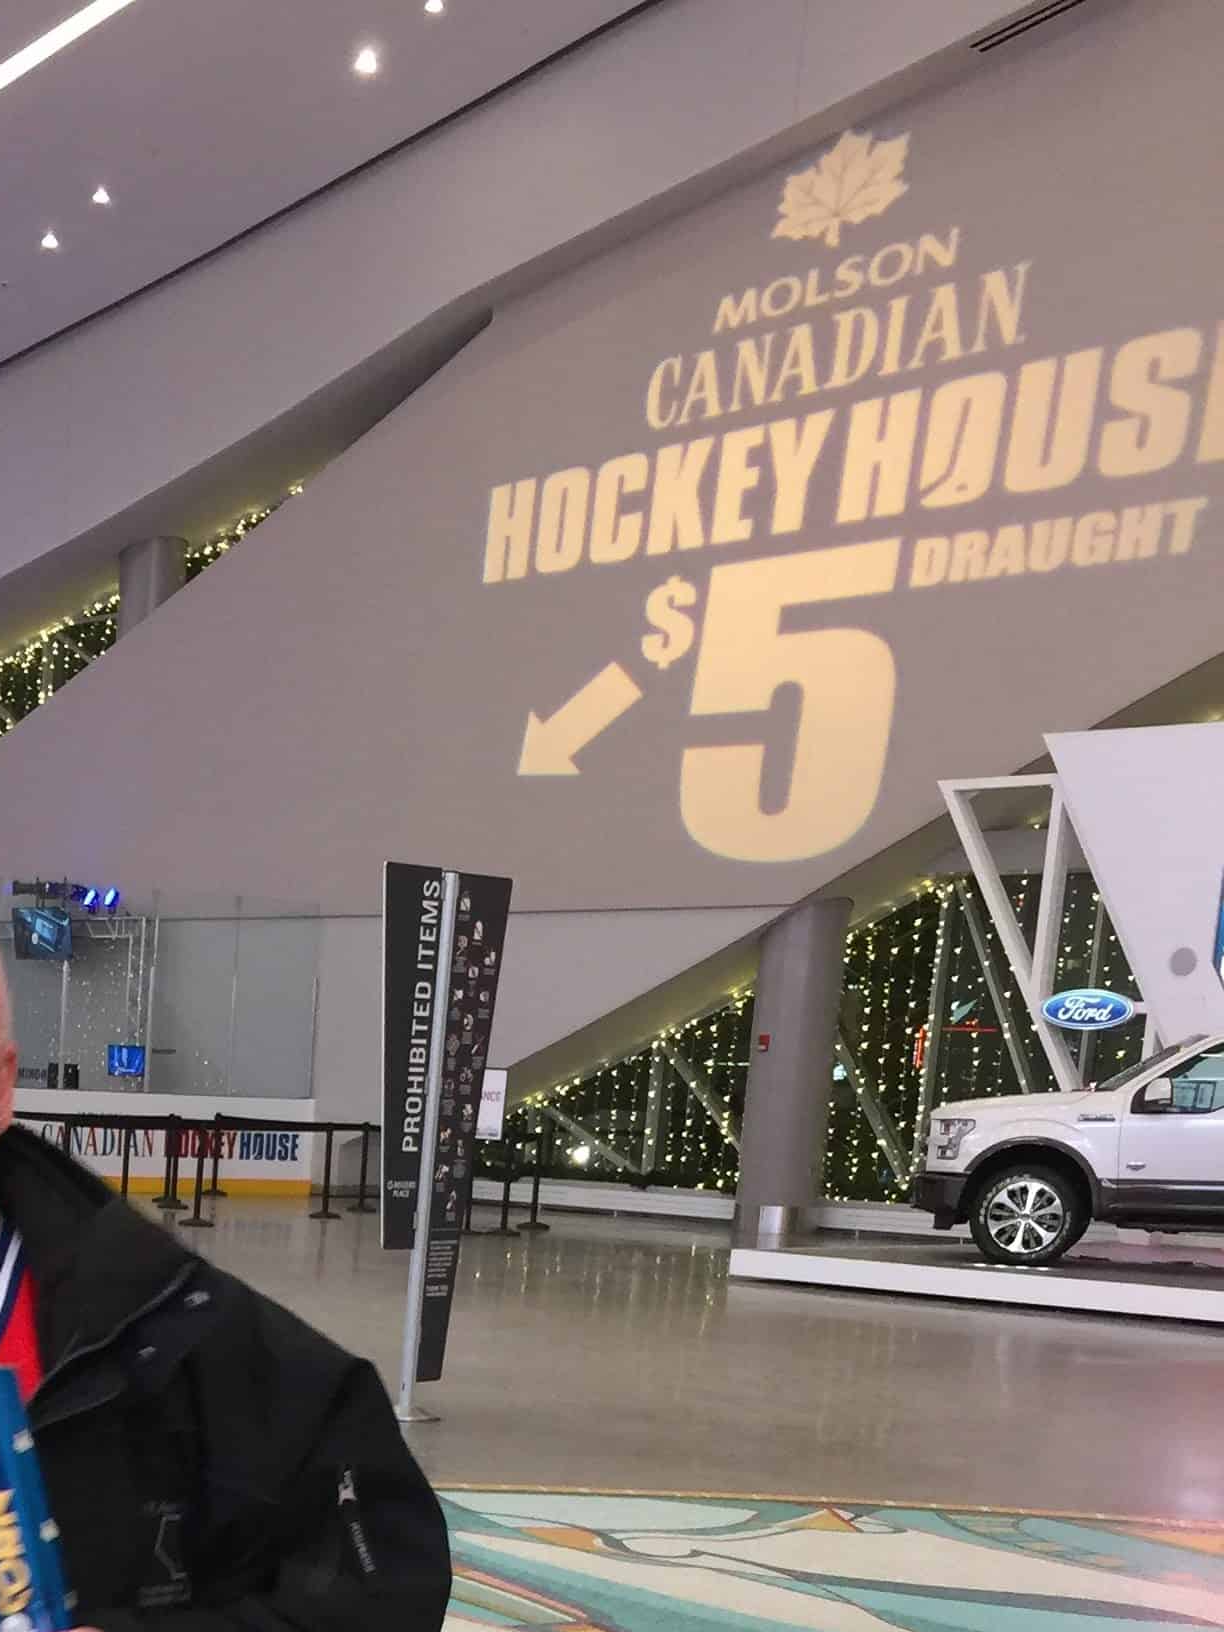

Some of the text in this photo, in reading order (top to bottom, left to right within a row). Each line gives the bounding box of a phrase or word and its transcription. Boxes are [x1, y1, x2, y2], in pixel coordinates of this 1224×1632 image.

[713, 226, 960, 332] MOLSON
[645, 261, 1032, 430] CANADIAN
[482, 407, 837, 585] HOCKEY
[908, 496, 1209, 589] DRAUGHT
[401, 879, 441, 1153] PROHIBITED ITEMS
[1057, 995, 1114, 1022] Ford
[238, 1131, 300, 1161] HOUSE
